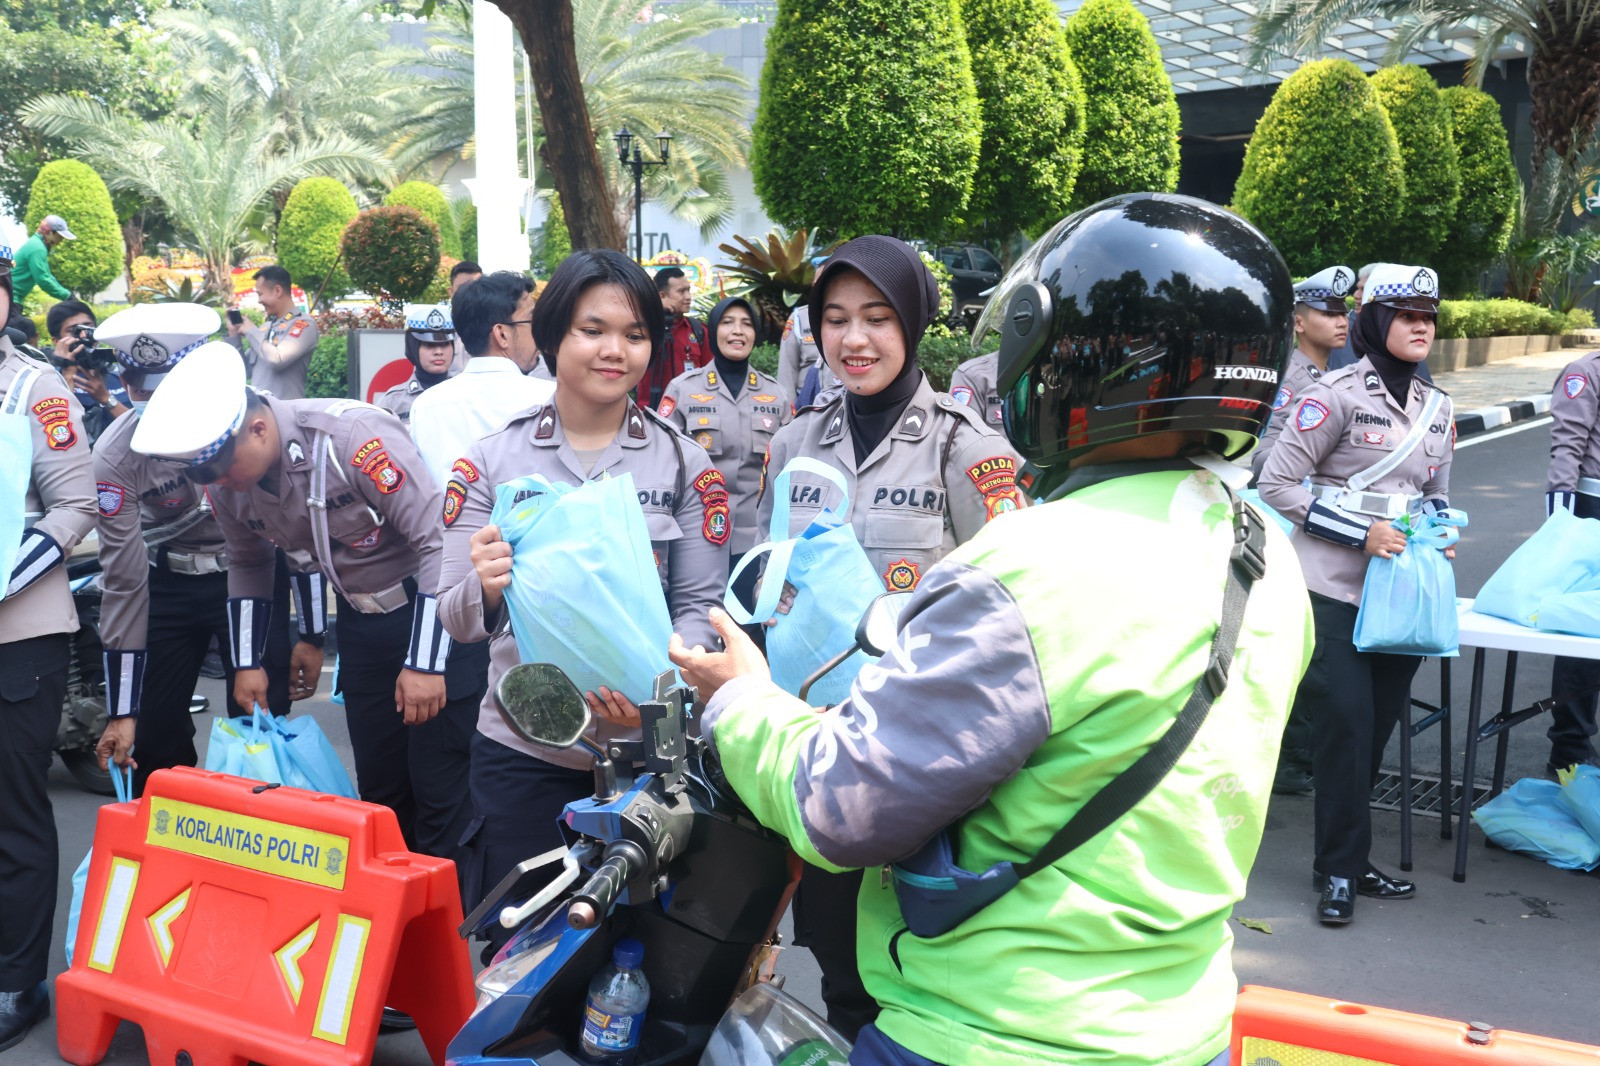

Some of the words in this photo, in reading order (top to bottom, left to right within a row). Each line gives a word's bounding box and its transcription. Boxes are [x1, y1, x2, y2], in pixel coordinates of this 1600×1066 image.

[1214, 366, 1278, 384] HONDA
[35, 398, 67, 413] POLDA
[688, 406, 712, 414] AGUSTIN
[753, 405, 780, 415] POLRI
[354, 440, 380, 464] POLDA
[971, 458, 1013, 479] POLDA
[980, 478, 1002, 490] METRO
[791, 485, 822, 504] LFA
[874, 487, 944, 511] POLRI
[175, 815, 263, 855] KORLANTAS
[266, 836, 320, 868] POLRI
